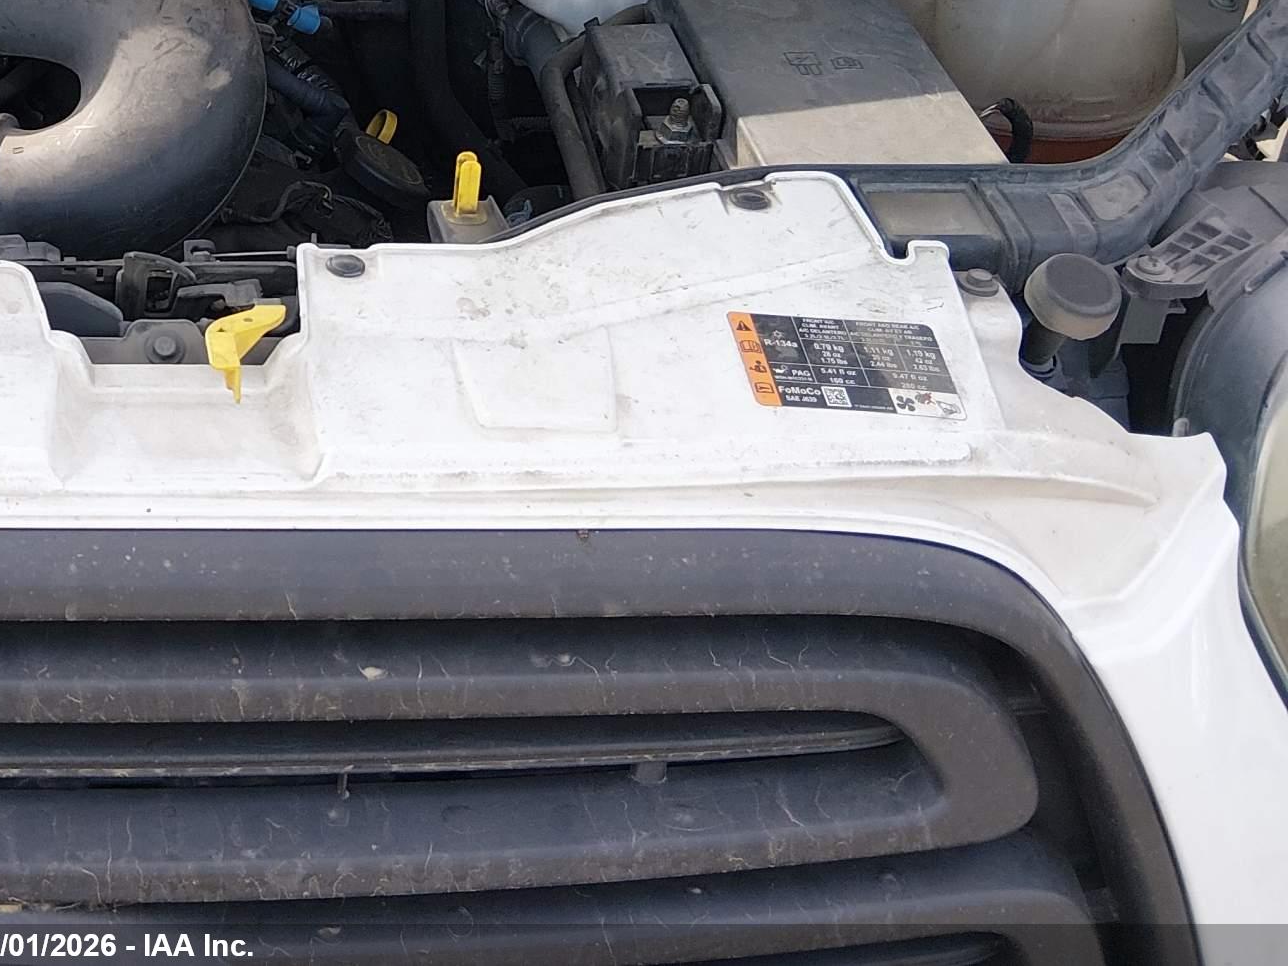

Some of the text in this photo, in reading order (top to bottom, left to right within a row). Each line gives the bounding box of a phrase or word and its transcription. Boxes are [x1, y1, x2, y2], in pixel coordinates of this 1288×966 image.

[763, 338, 798, 348] R-134a
[832, 344, 845, 353] kg
[881, 347, 894, 356] kg
[924, 350, 937, 360] kg
[792, 369, 811, 377] PAG
[778, 385, 821, 396] FoMoCo
